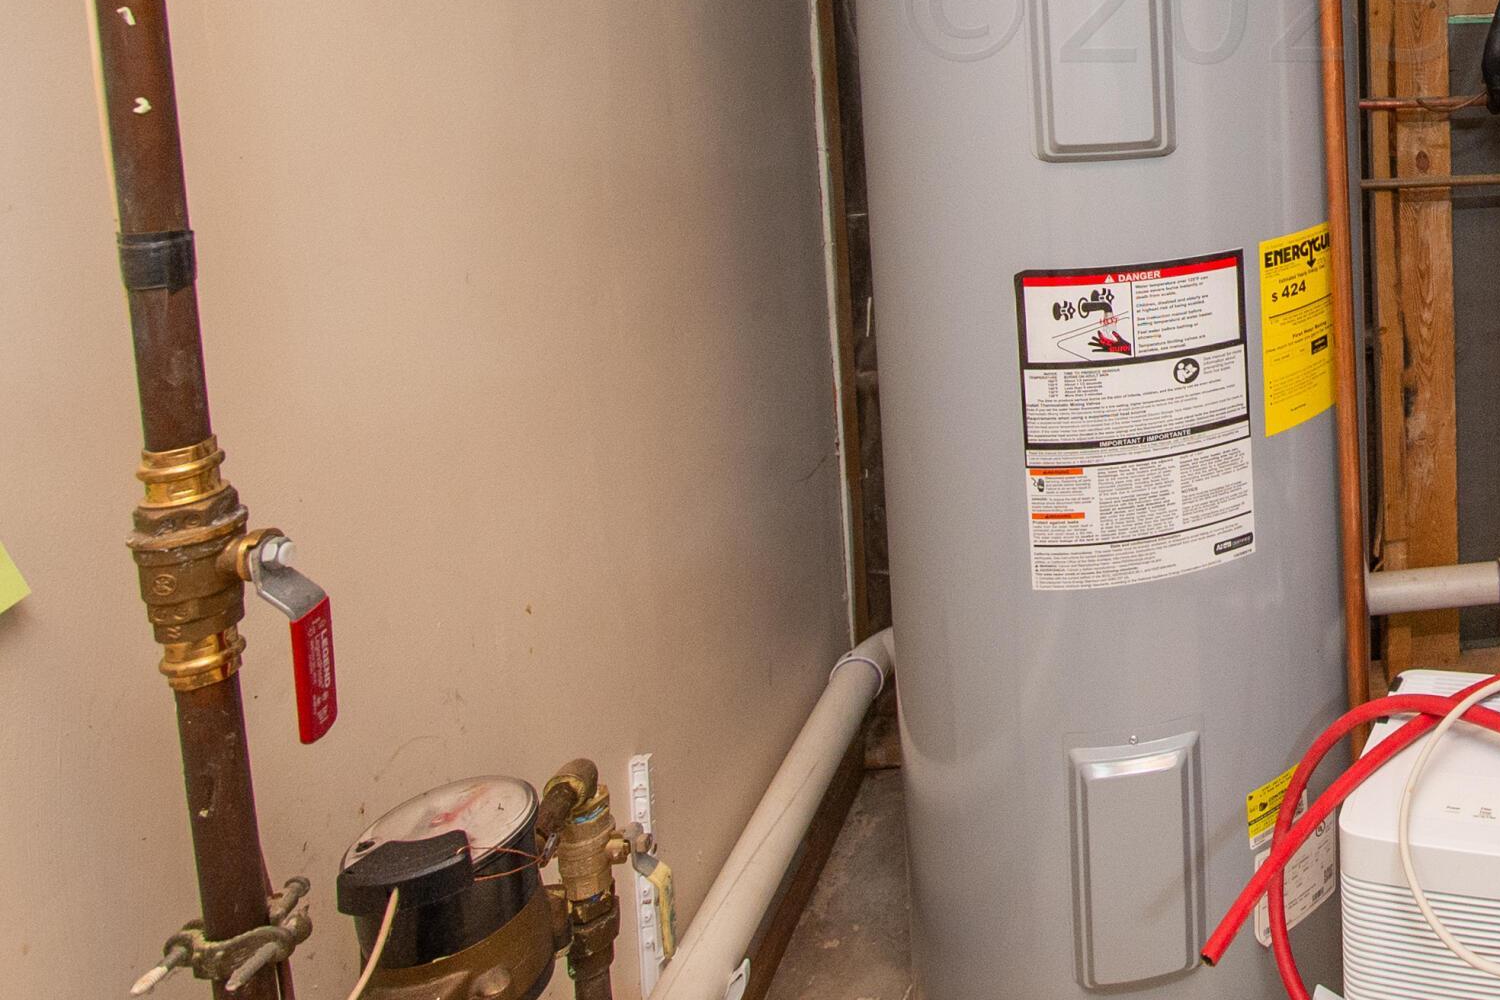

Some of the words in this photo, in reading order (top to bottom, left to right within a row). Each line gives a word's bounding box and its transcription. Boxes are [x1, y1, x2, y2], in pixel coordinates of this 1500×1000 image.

[1264, 232, 1330, 268] ENERGYGUI
[1118, 270, 1161, 283] DANGER
[1271, 292, 1279, 303] $
[1281, 279, 1307, 298] 424
[1099, 437, 1141, 447] IMPORTANT
[1146, 429, 1191, 442] IMPORTANTE
